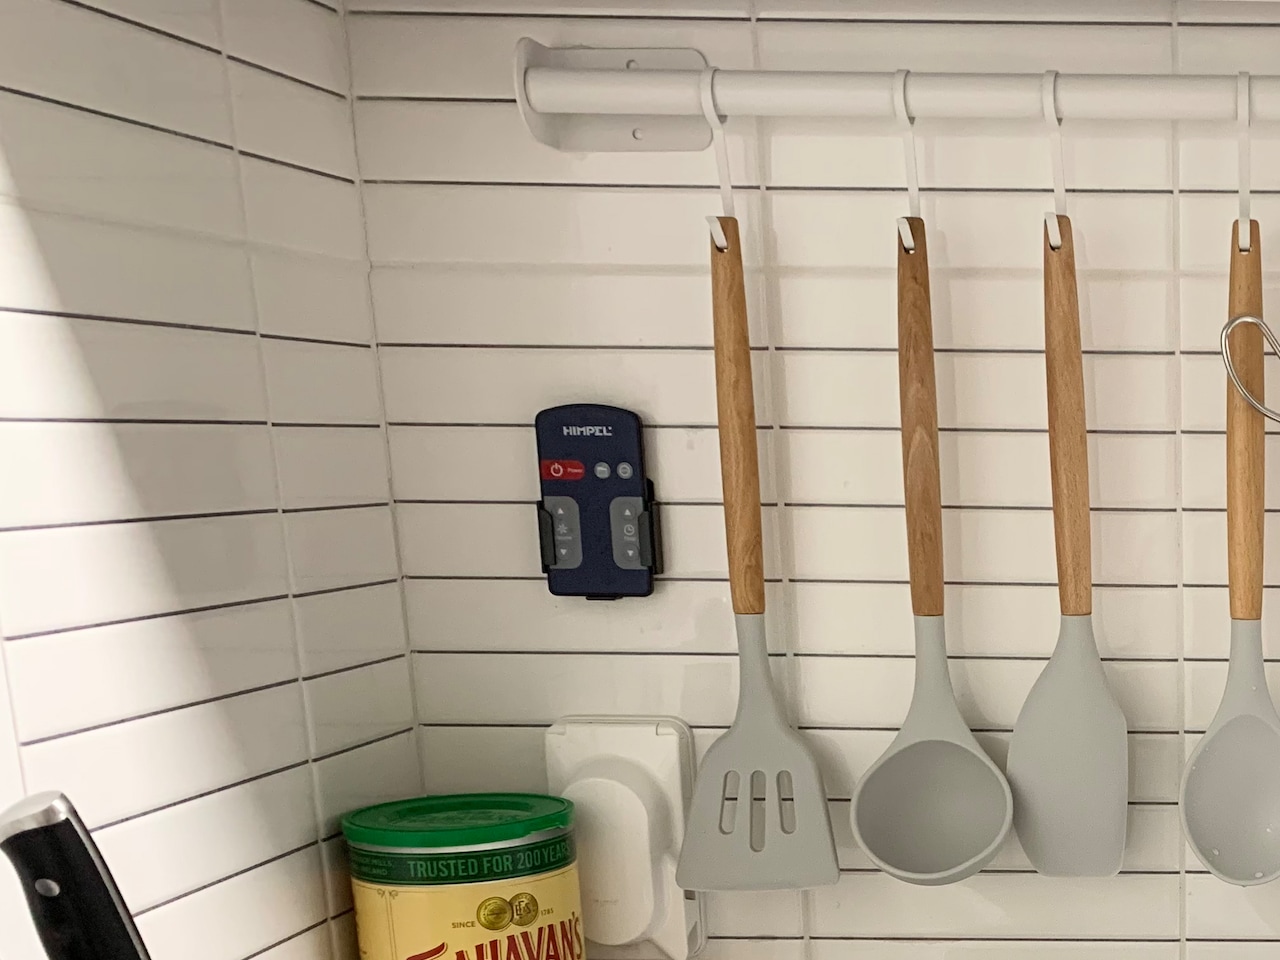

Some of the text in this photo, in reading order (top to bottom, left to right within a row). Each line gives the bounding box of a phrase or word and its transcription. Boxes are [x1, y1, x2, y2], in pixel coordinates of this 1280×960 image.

[562, 426, 613, 436] HIMPEL
[407, 858, 479, 878] TRUSTED
[483, 855, 514, 874] FOR
[517, 850, 541, 869] 200
[451, 921, 477, 929] SINCE
